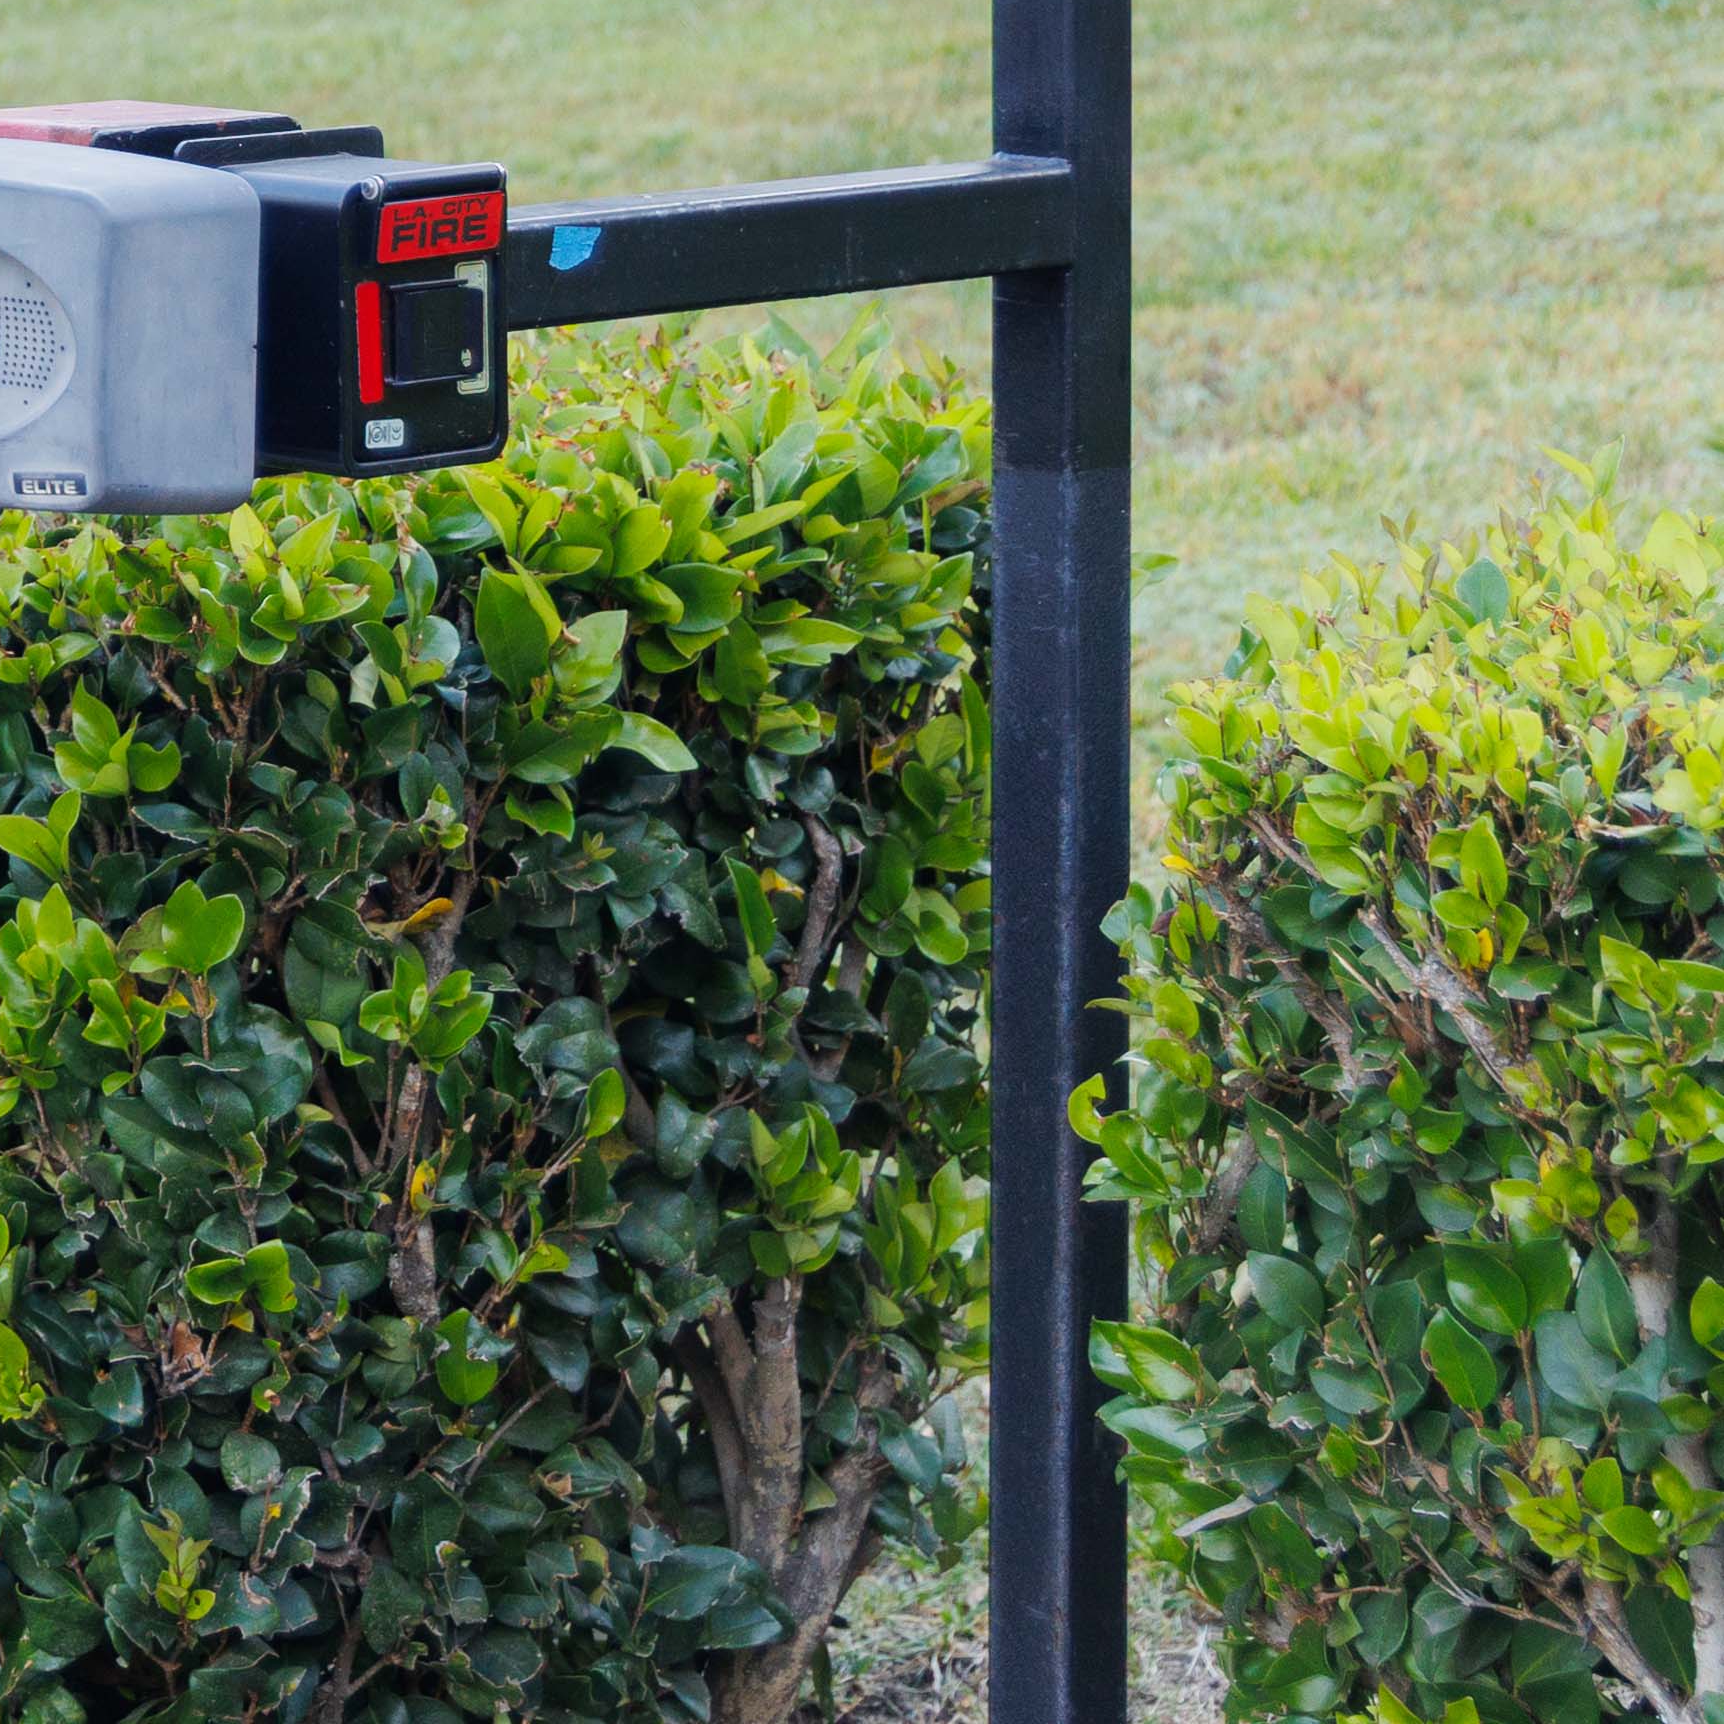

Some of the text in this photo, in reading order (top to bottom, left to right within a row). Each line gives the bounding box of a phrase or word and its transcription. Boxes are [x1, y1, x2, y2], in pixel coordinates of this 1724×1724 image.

[442, 197, 488, 215] CITY
[391, 213, 488, 252] FIRE
[22, 479, 78, 494] ELITE
